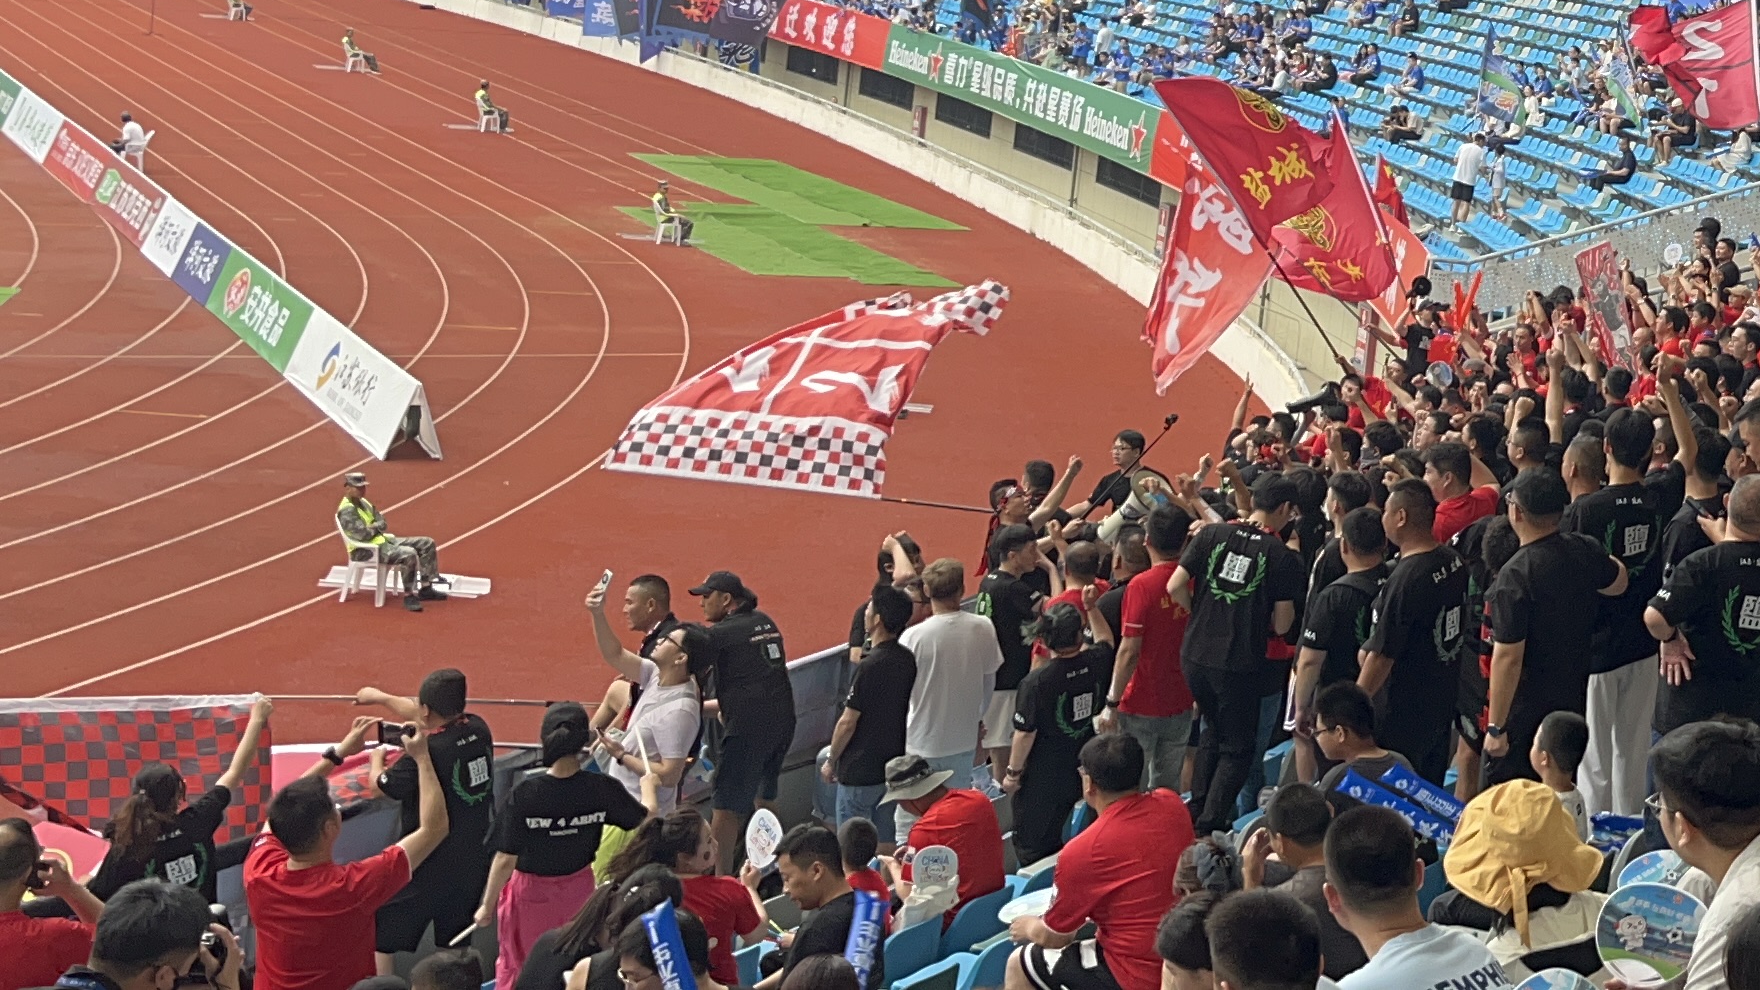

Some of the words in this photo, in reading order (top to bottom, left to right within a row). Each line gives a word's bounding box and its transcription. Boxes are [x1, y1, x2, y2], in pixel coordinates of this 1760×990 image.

[769, 1, 857, 58] 迁欢迎您
[888, 41, 929, 74] Heineken
[1083, 106, 1130, 151] Heineken
[239, 285, 291, 347] 安井食品
[557, 817, 566, 828] 4
